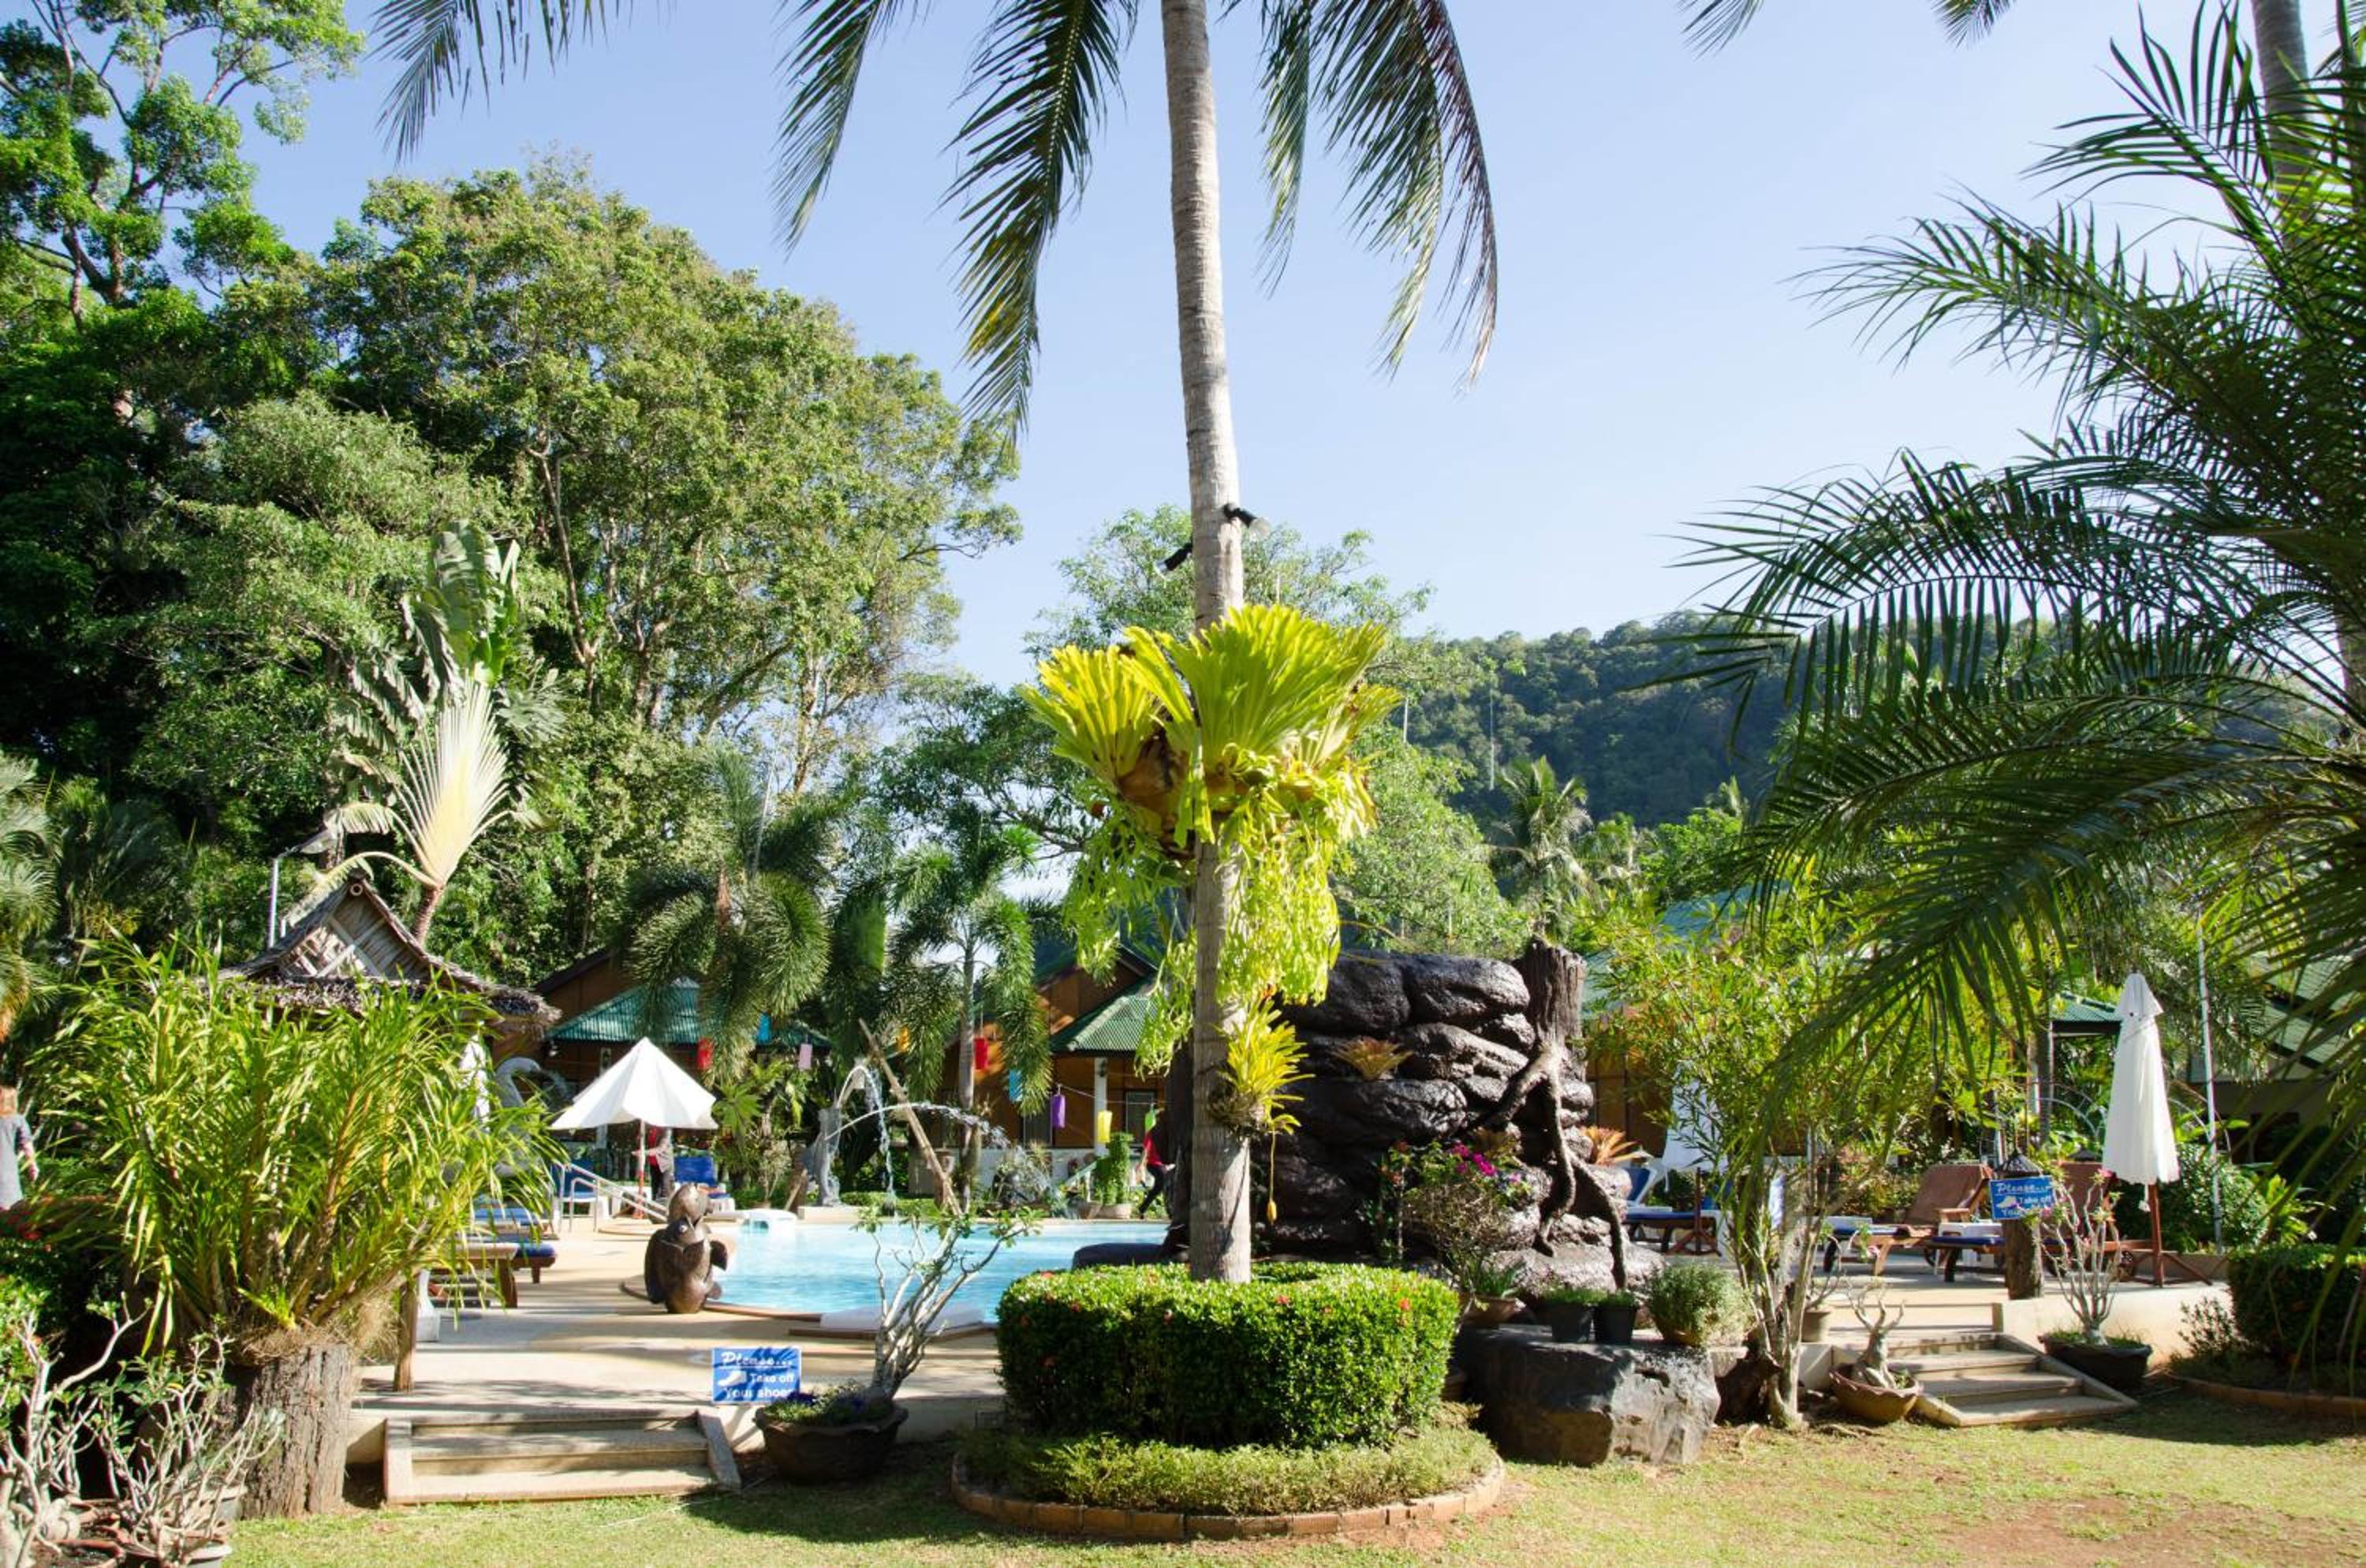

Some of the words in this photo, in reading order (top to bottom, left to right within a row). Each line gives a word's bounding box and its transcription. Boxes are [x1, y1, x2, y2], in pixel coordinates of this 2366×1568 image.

[749, 1372, 778, 1383] Take
[778, 1371, 795, 1383] off
[726, 1387, 753, 1399] Your
